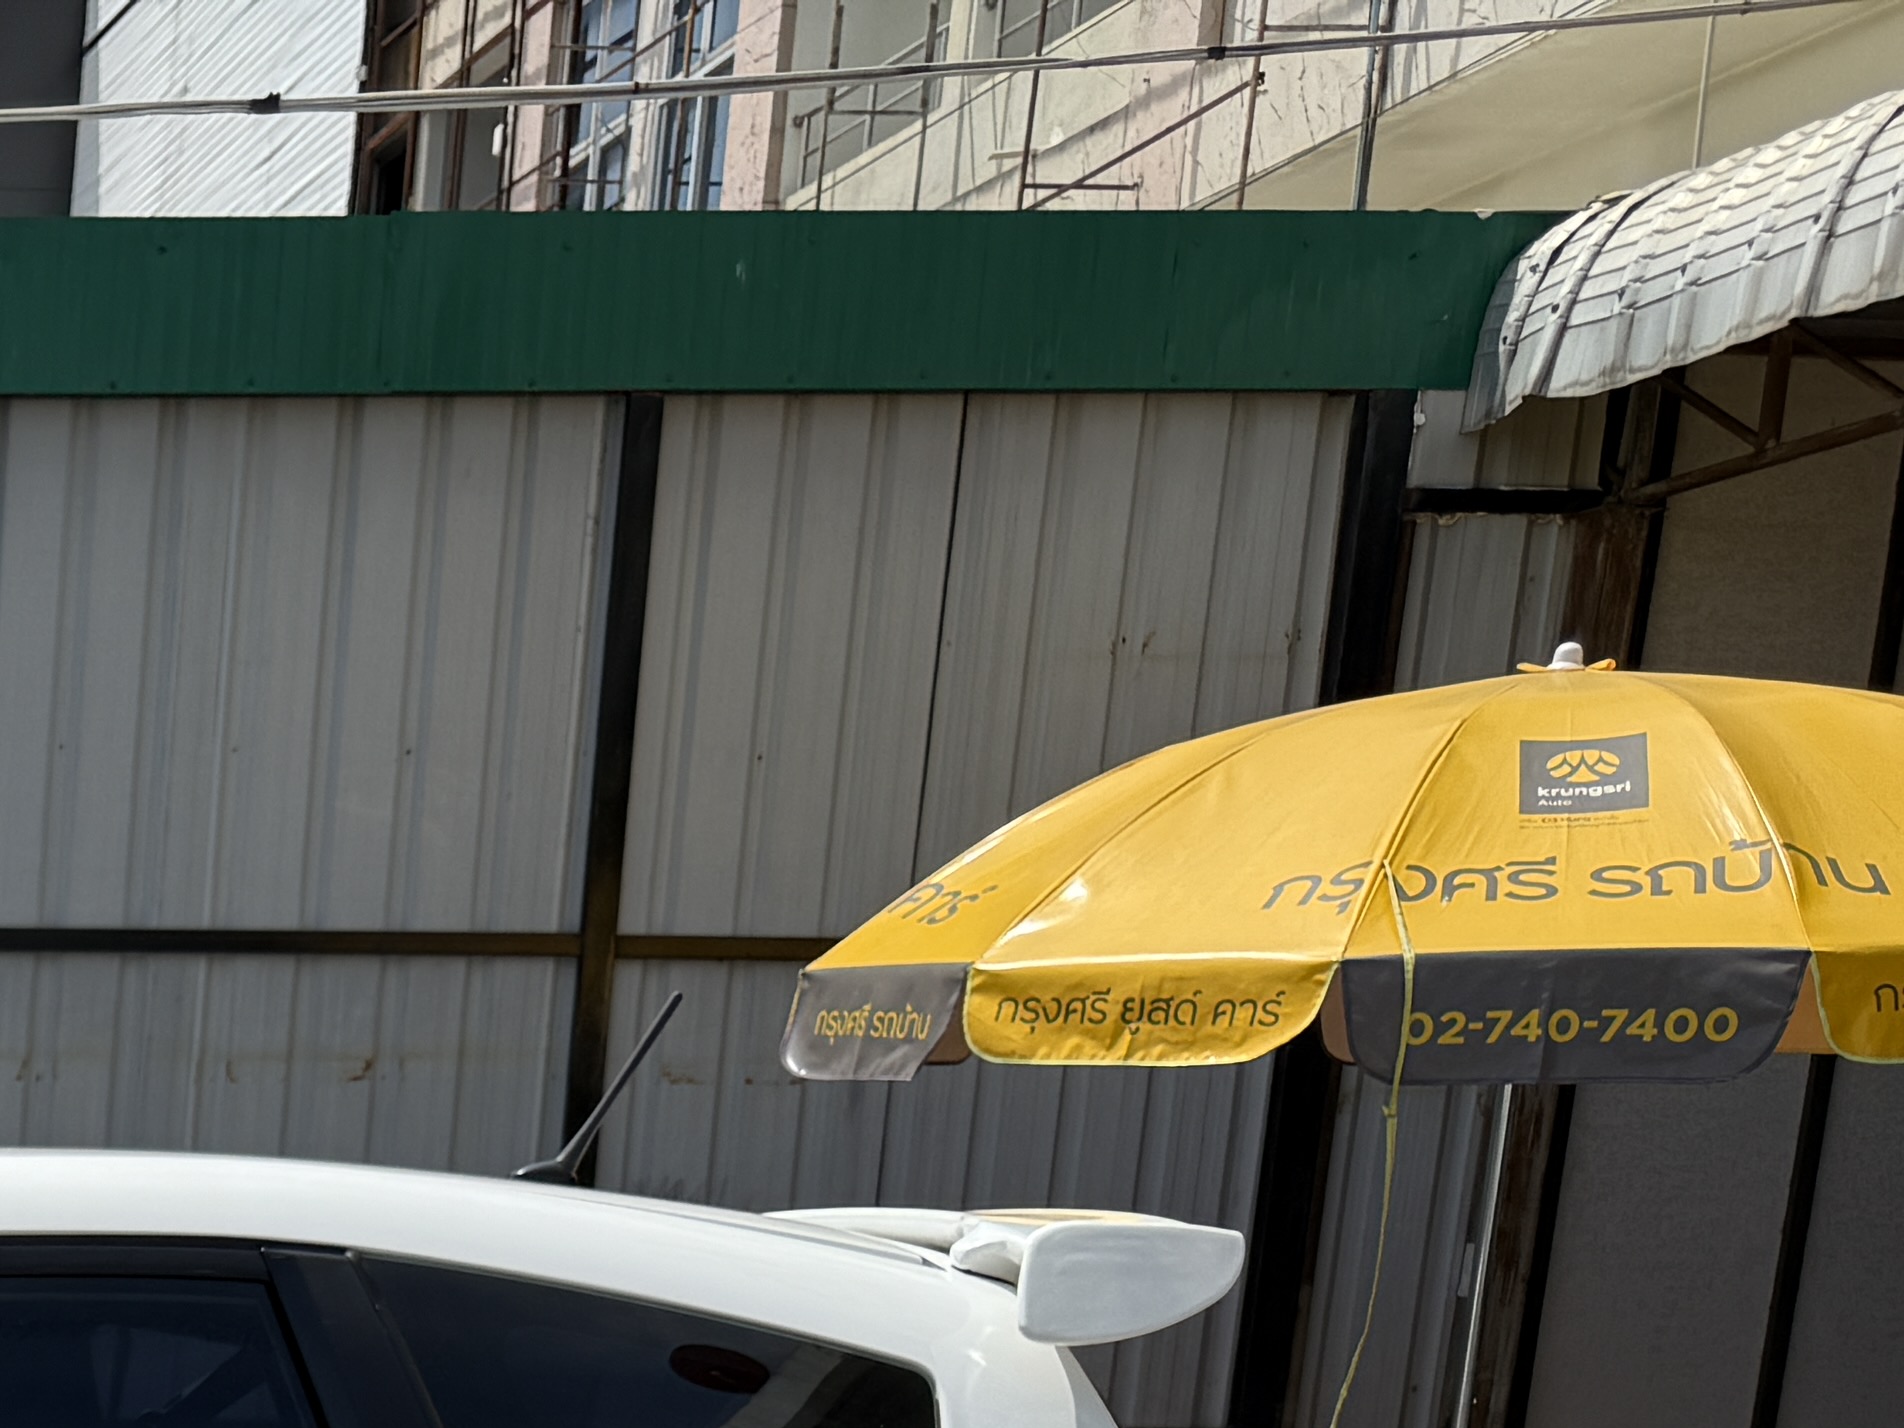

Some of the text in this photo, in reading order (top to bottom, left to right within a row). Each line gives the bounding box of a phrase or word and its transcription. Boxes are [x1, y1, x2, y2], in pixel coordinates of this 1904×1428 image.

[1537, 779, 1631, 797] krungsri
[1538, 798, 1573, 807] Auto
[1261, 838, 1891, 916] กรุงศรี รถบ้าน
[814, 1002, 932, 1046] กรุงศรี รถบ้าน
[995, 987, 1286, 1036] กรุงศรี ยูสด์ คาร์
[1406, 1006, 1739, 1046] 02-740-7400
